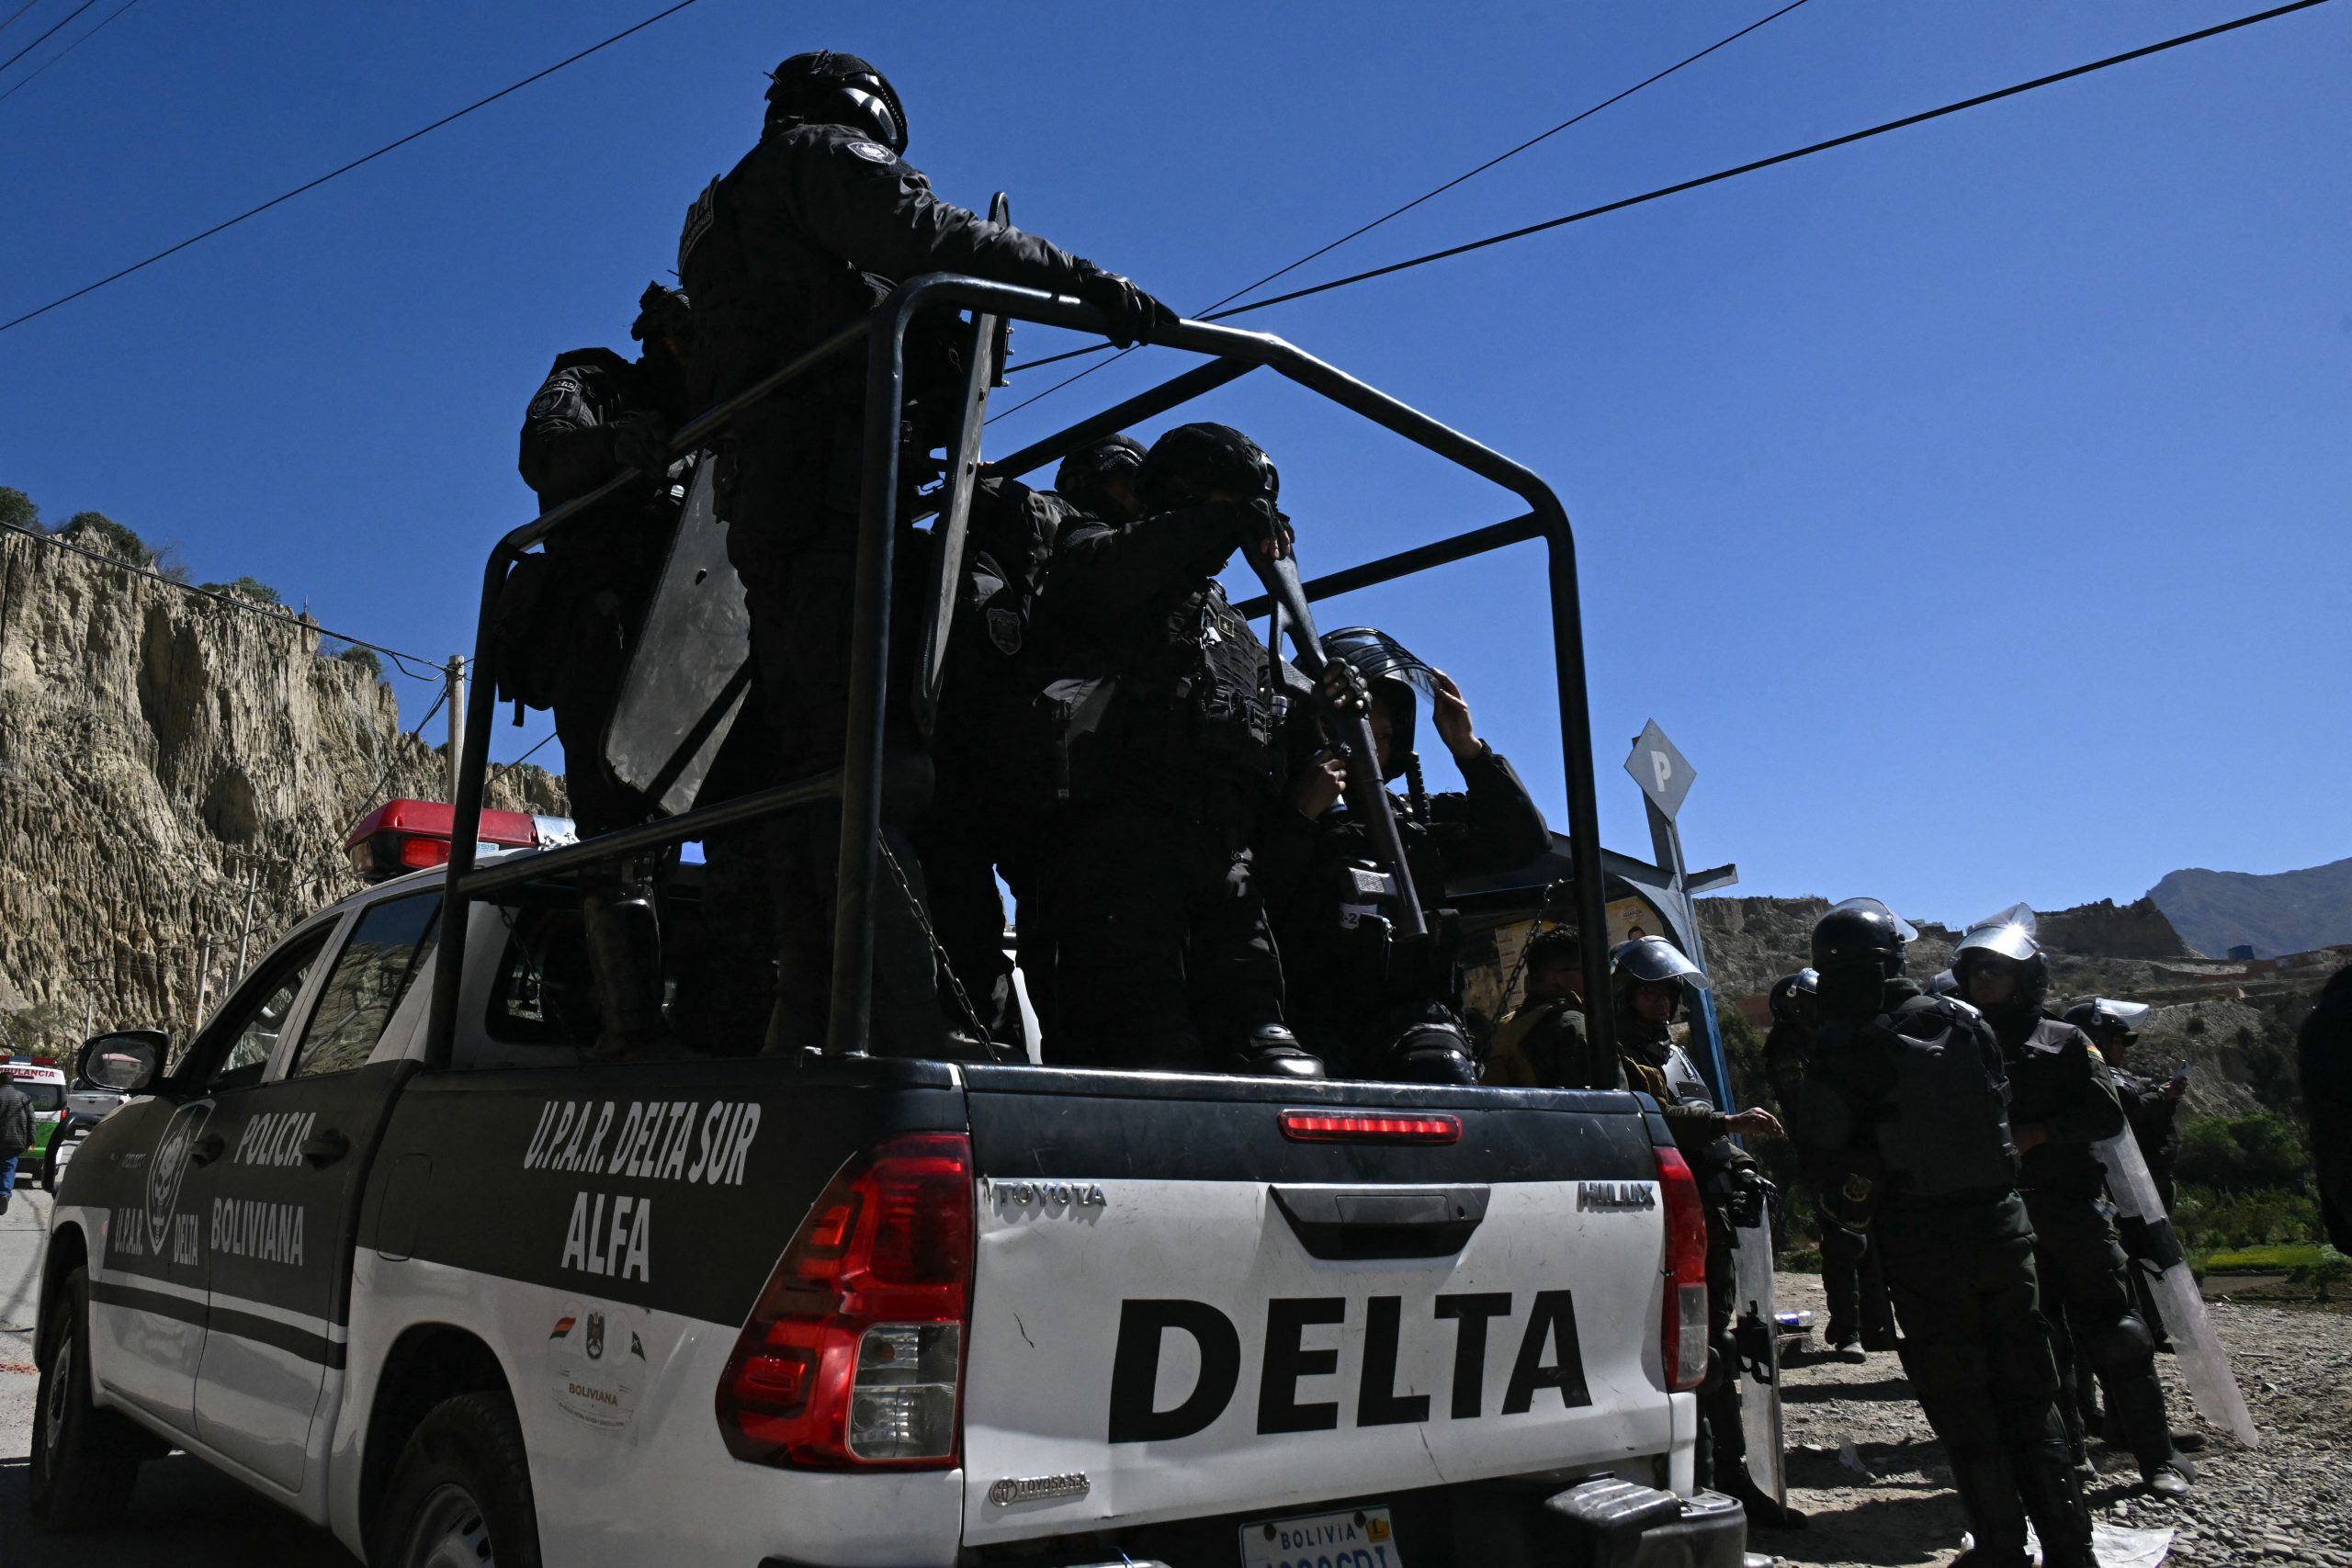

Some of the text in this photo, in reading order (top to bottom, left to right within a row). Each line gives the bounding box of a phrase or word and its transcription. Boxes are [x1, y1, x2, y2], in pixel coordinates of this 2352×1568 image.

[1651, 750, 1671, 792] P
[233, 1111, 316, 1167] POLICIA
[524, 1100, 762, 1186] U.P.A.R. DELTA SUR
[994, 1181, 1108, 1207] TOYOTA
[1577, 1181, 1657, 1207] HILUX
[174, 1213, 199, 1266] DELTA
[210, 1197, 304, 1267] BOLIVIANA
[560, 1191, 650, 1283] ALFA
[1108, 1290, 1593, 1444] DELTA
[568, 1382, 618, 1407] BOLIVIANA
[1018, 1473, 1067, 1494] TOYOSA
[1281, 1523, 1357, 1551] BOLIVIA
